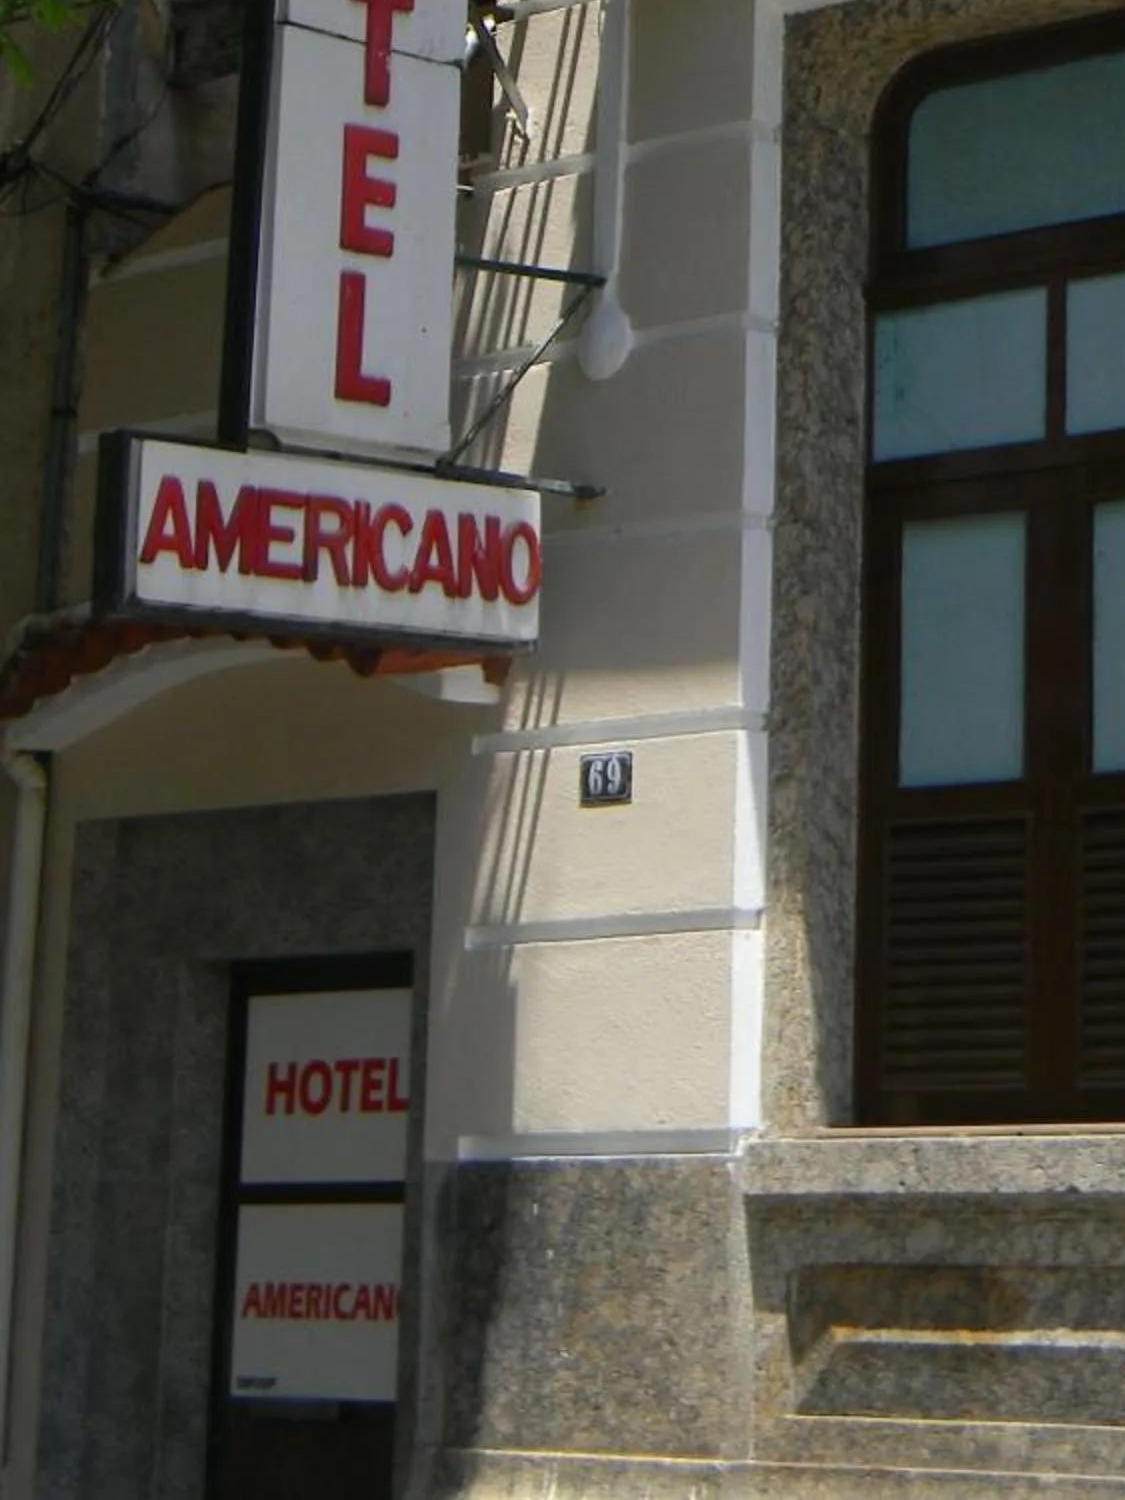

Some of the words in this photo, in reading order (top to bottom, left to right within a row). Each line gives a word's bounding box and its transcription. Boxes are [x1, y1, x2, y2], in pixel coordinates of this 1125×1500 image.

[141, 474, 542, 607] AMERICANO
[588, 757, 621, 795] 69
[264, 1058, 409, 1116] HOTEL
[241, 1282, 401, 1321] AMERICAN
